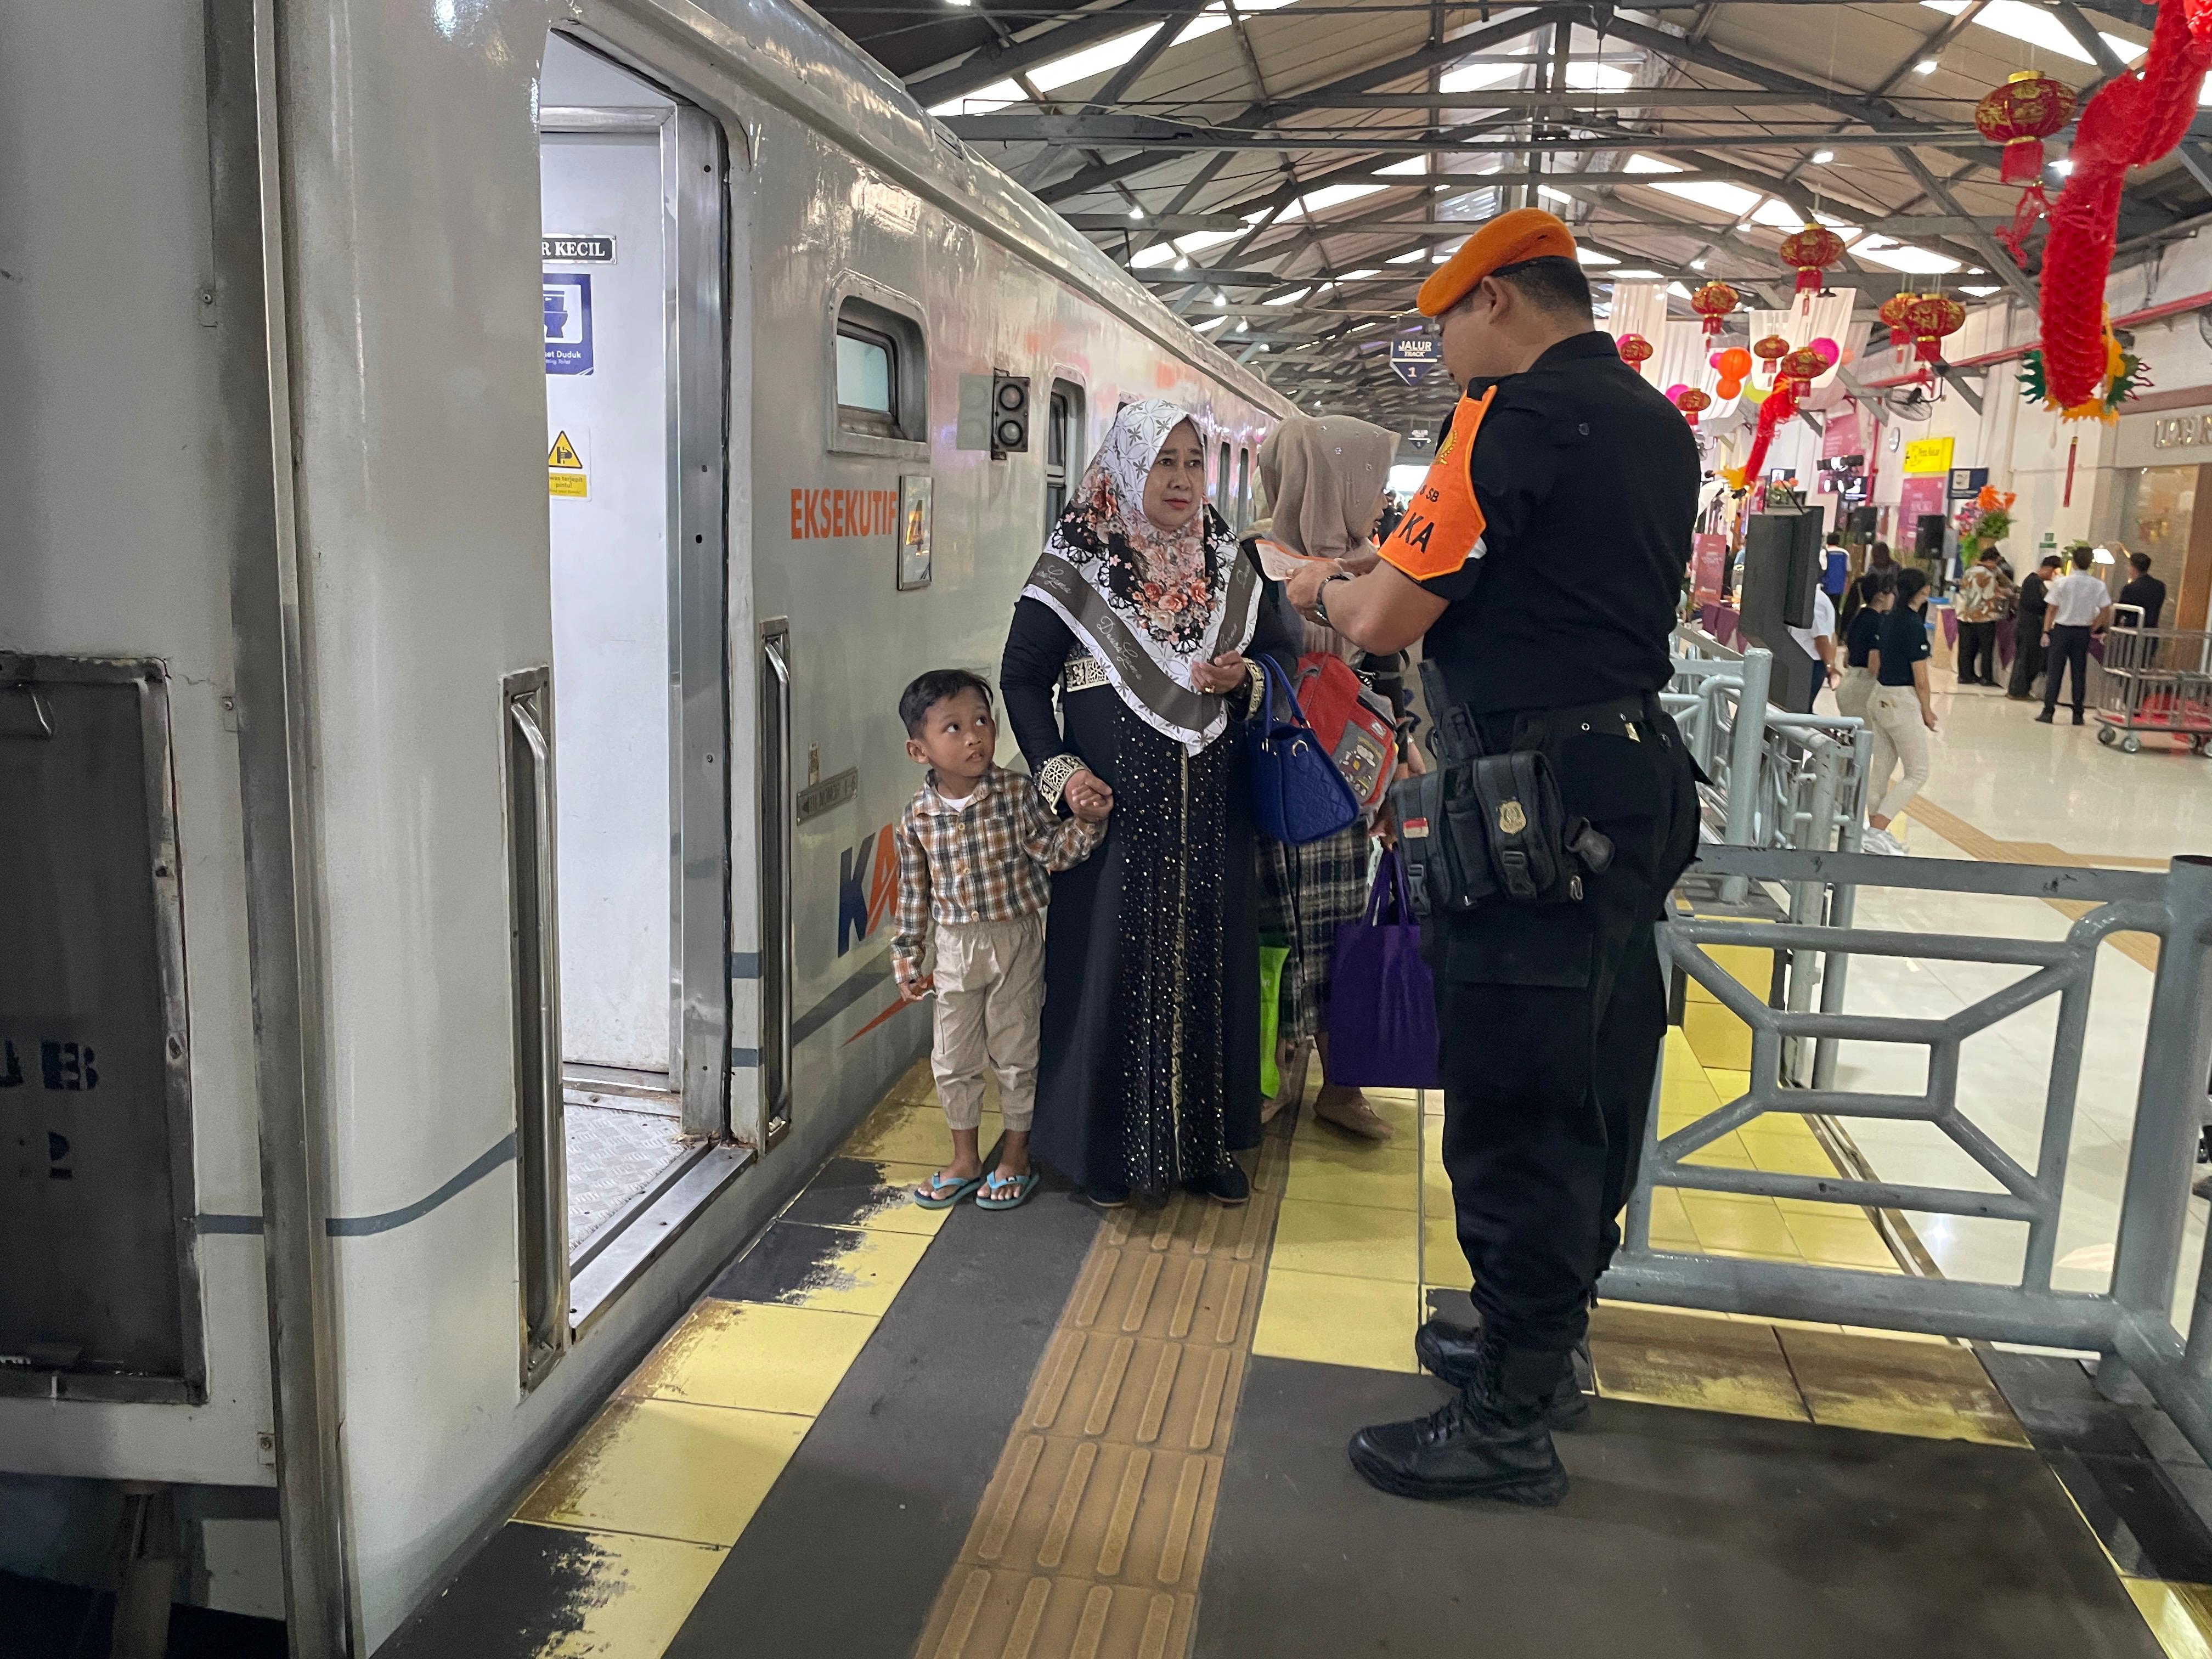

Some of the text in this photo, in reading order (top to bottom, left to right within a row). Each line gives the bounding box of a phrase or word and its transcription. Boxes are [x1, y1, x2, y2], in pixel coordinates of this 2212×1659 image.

[542, 242, 605, 256] R KECIL
[1398, 341, 1431, 351] JALUR
[1408, 367, 1417, 377] 1
[1426, 488, 1439, 502] SB
[791, 488, 897, 539] EKSEKUTIF
[905, 499, 925, 553] 4
[1398, 512, 1434, 554] KA
